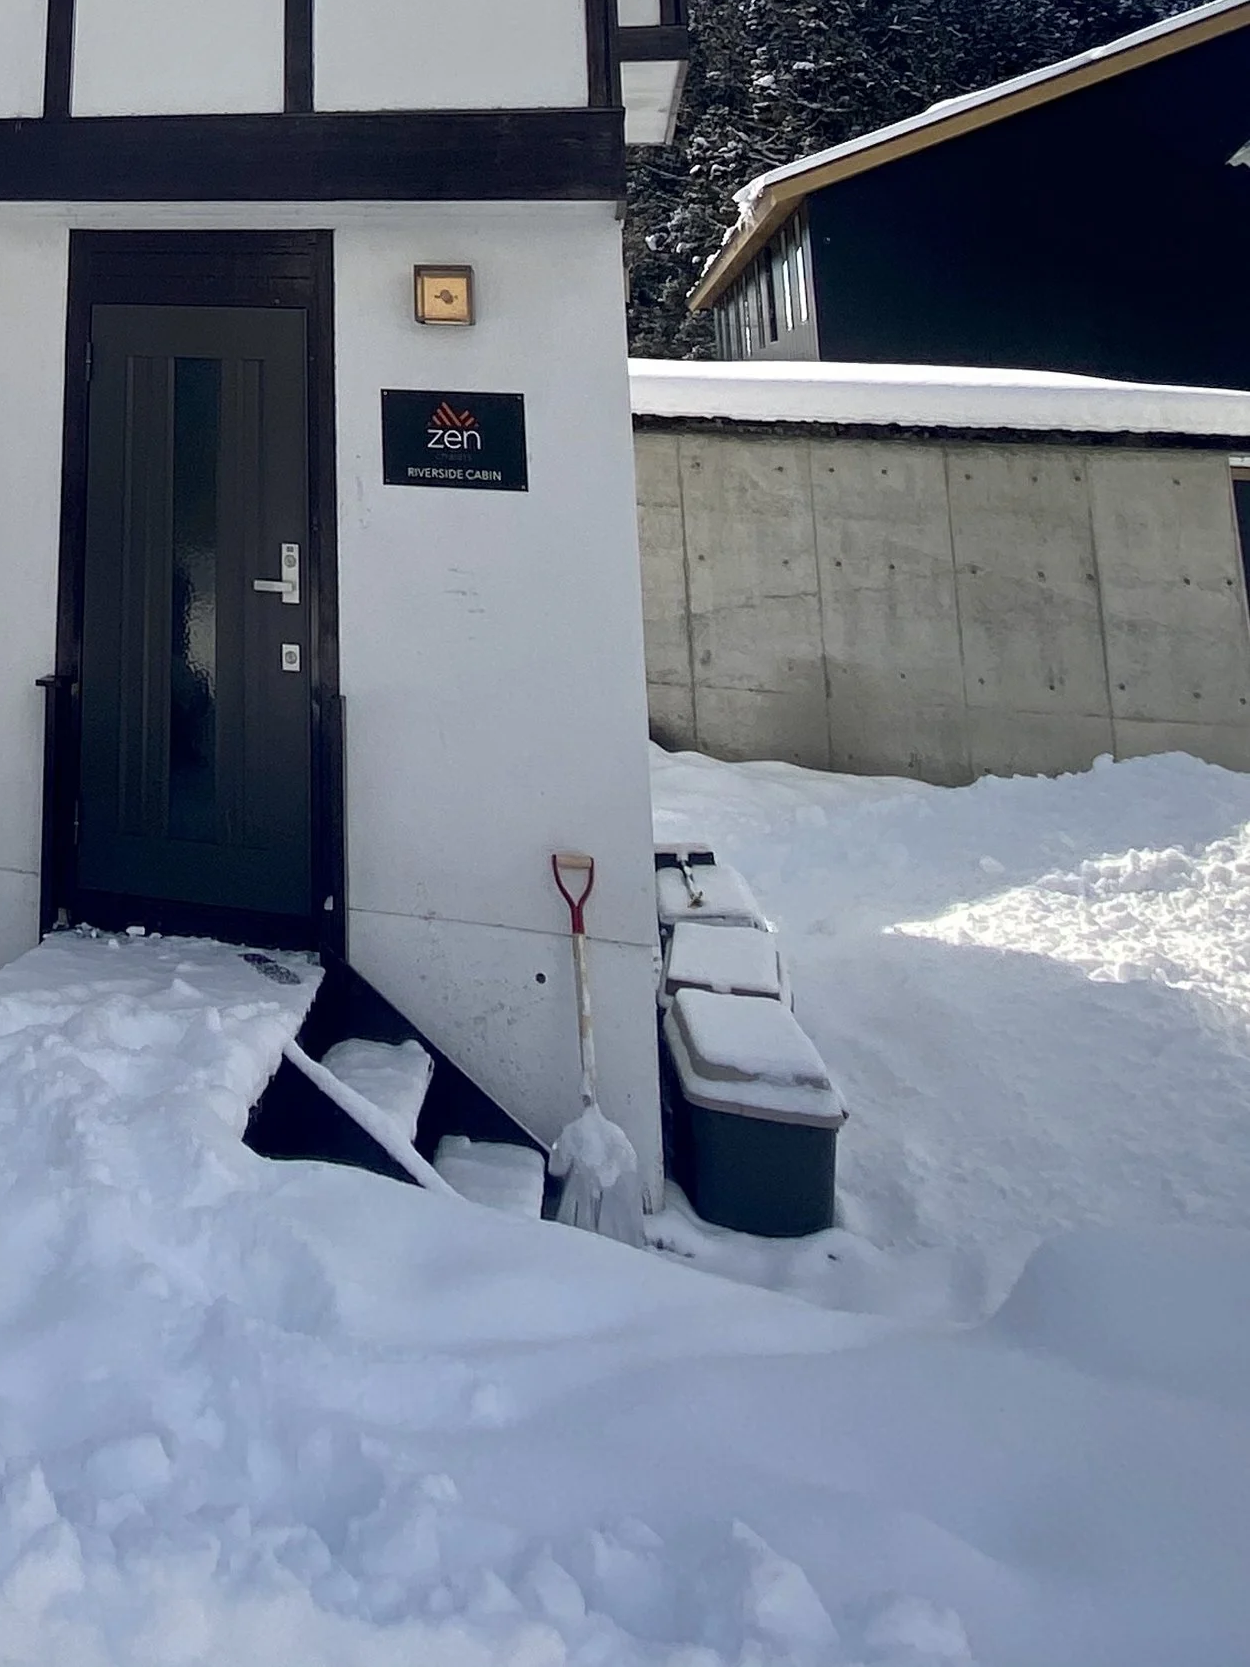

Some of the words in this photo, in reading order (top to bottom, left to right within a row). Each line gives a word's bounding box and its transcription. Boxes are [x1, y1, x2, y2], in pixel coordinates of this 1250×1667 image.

[427, 429, 481, 450] zen
[407, 467, 463, 480] RIVERSIDE
[465, 469, 502, 481] CABIN
